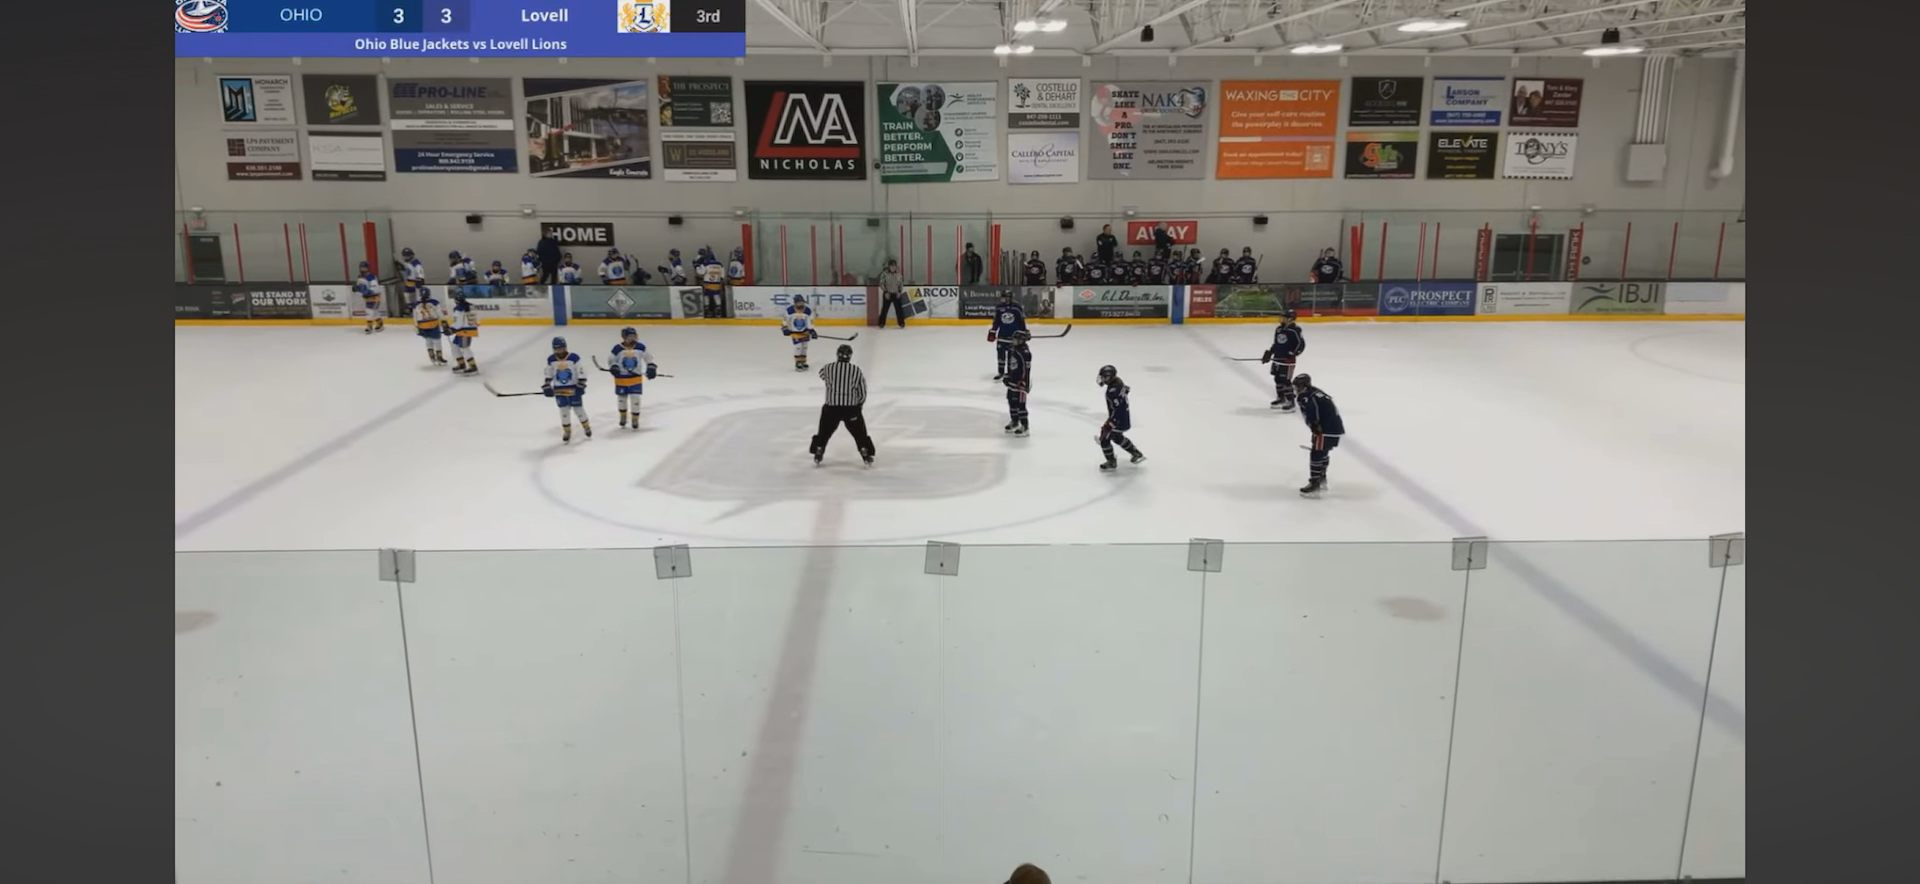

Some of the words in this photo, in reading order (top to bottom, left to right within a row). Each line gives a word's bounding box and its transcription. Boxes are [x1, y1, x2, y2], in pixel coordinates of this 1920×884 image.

[417, 86, 487, 98] PRO-LINE
[1036, 83, 1077, 92] COSTELLO
[1446, 86, 1480, 98] LARSON
[1037, 93, 1043, 101] &
[1045, 93, 1076, 101] DEHART
[1111, 90, 1140, 98] SKATE
[1225, 90, 1278, 101] WAXING
[1299, 89, 1333, 101] CITY
[883, 122, 914, 131] TRAIN
[884, 132, 924, 141] BETTER.
[1438, 135, 1488, 148] ELEVATE
[884, 142, 932, 152] PERFORM
[885, 153, 925, 162] BETTER.
[761, 158, 856, 170] NICHOLAS
[550, 227, 607, 242] HOME
[914, 288, 959, 298] ARCON
[1410, 290, 1472, 301] PROSPECT
[1618, 284, 1659, 303] IBJI
[252, 298, 274, 306] OUR
[275, 298, 308, 306] WORK
